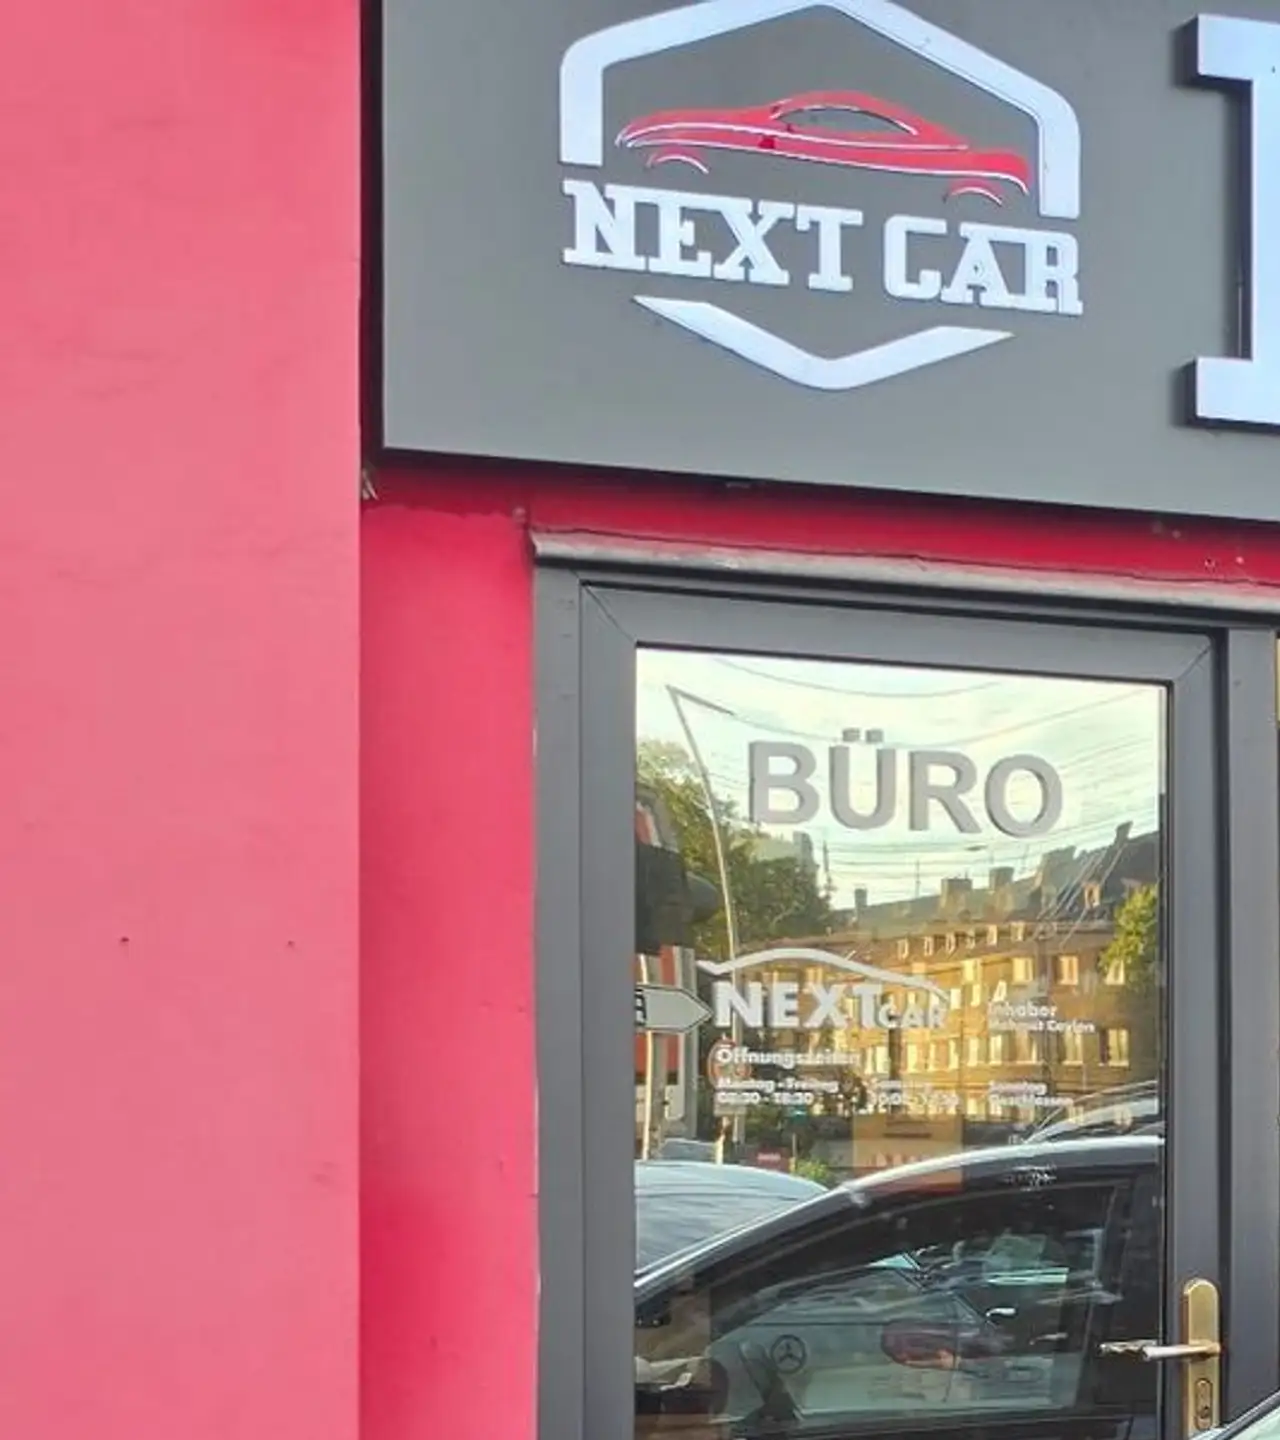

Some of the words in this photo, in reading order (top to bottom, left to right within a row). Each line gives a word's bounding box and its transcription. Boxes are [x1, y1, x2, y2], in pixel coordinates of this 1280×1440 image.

[562, 180, 863, 291] NEXT
[883, 214, 1083, 316] CAR
[747, 728, 1063, 838] BÜRO
